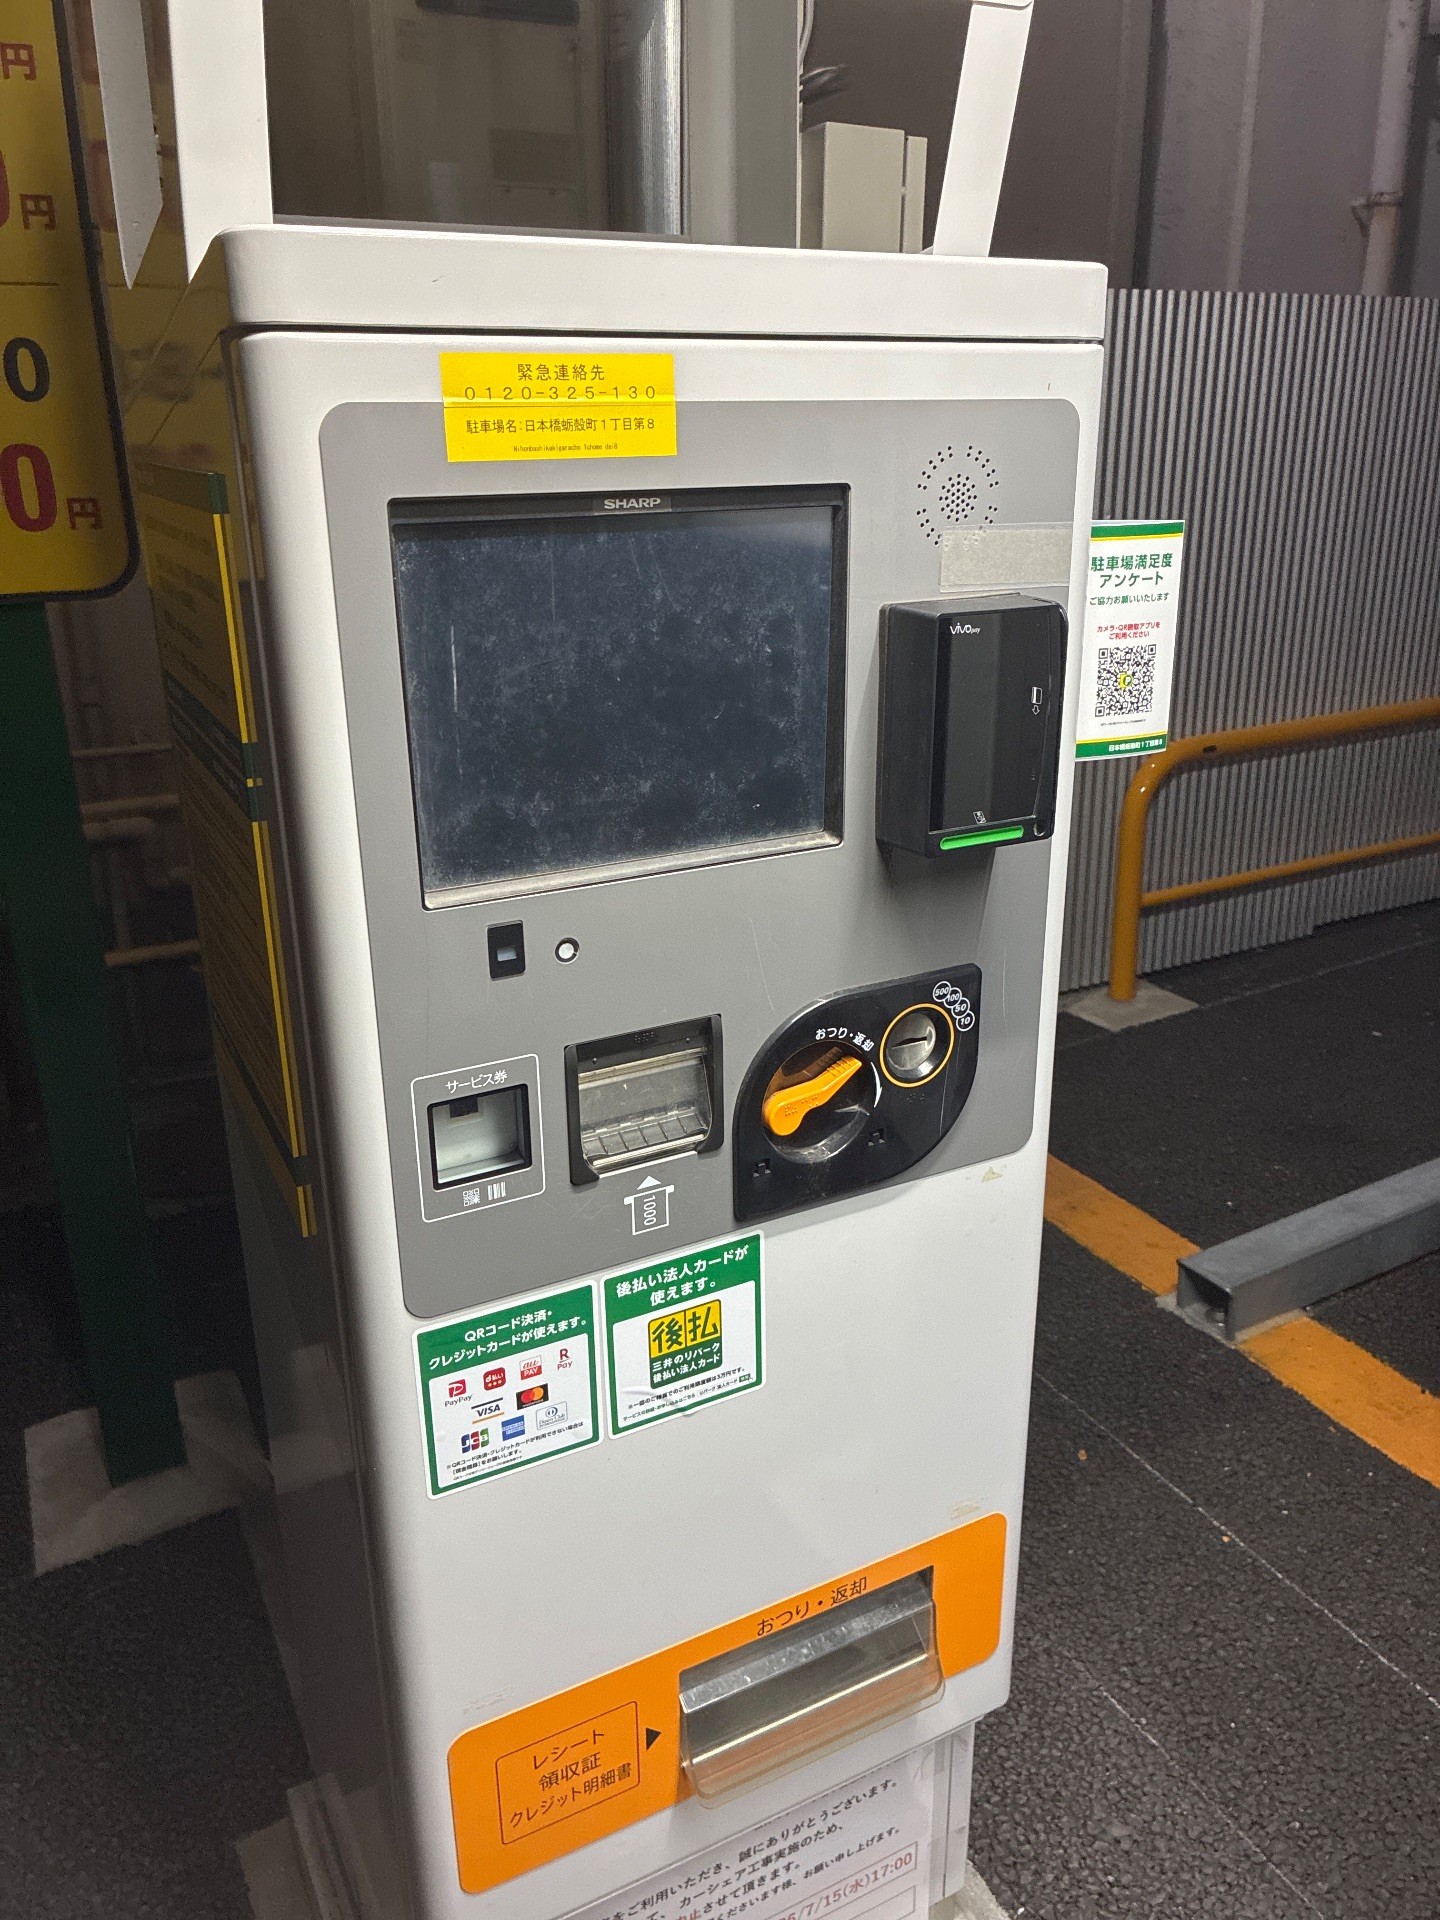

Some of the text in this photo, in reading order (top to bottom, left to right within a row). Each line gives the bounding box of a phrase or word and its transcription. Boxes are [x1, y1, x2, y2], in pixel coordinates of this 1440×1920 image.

[517, 363, 606, 382] 緊急連絡先
[464, 386, 657, 401] 0120-325-130
[604, 497, 661, 510] SHARP
[1090, 552, 1174, 572] 駐車場満足度
[1099, 570, 1165, 589] アンケート
[1089, 592, 1170, 606] ご協力お願いいたします
[934, 986, 950, 997] 500
[947, 992, 960, 1002] 100
[955, 1003, 968, 1012] 50
[960, 1016, 971, 1026] 10
[814, 1026, 875, 1052] おつり・返却
[445, 1069, 508, 1094] サービス券
[642, 1194, 657, 1227] 1000
[615, 1244, 750, 1298] 後払い法人カードが
[649, 1276, 717, 1307] 使えます。
[651, 1306, 720, 1354] 後払
[428, 1316, 588, 1371] クレジットカードが使えます。
[652, 1342, 721, 1372] 三井のリパーク
[523, 1368, 539, 1377] PAY
[652, 1354, 721, 1384] 後払い法人カード
[444, 1395, 473, 1408] PayPay
[476, 1403, 502, 1417] VISA
[461, 1430, 490, 1453] JCB
[756, 1576, 868, 1638] おつり・返却
[532, 1728, 606, 1770] レシート
[538, 1753, 602, 1791] 領収証
[509, 1762, 632, 1829] クレジット明細書
